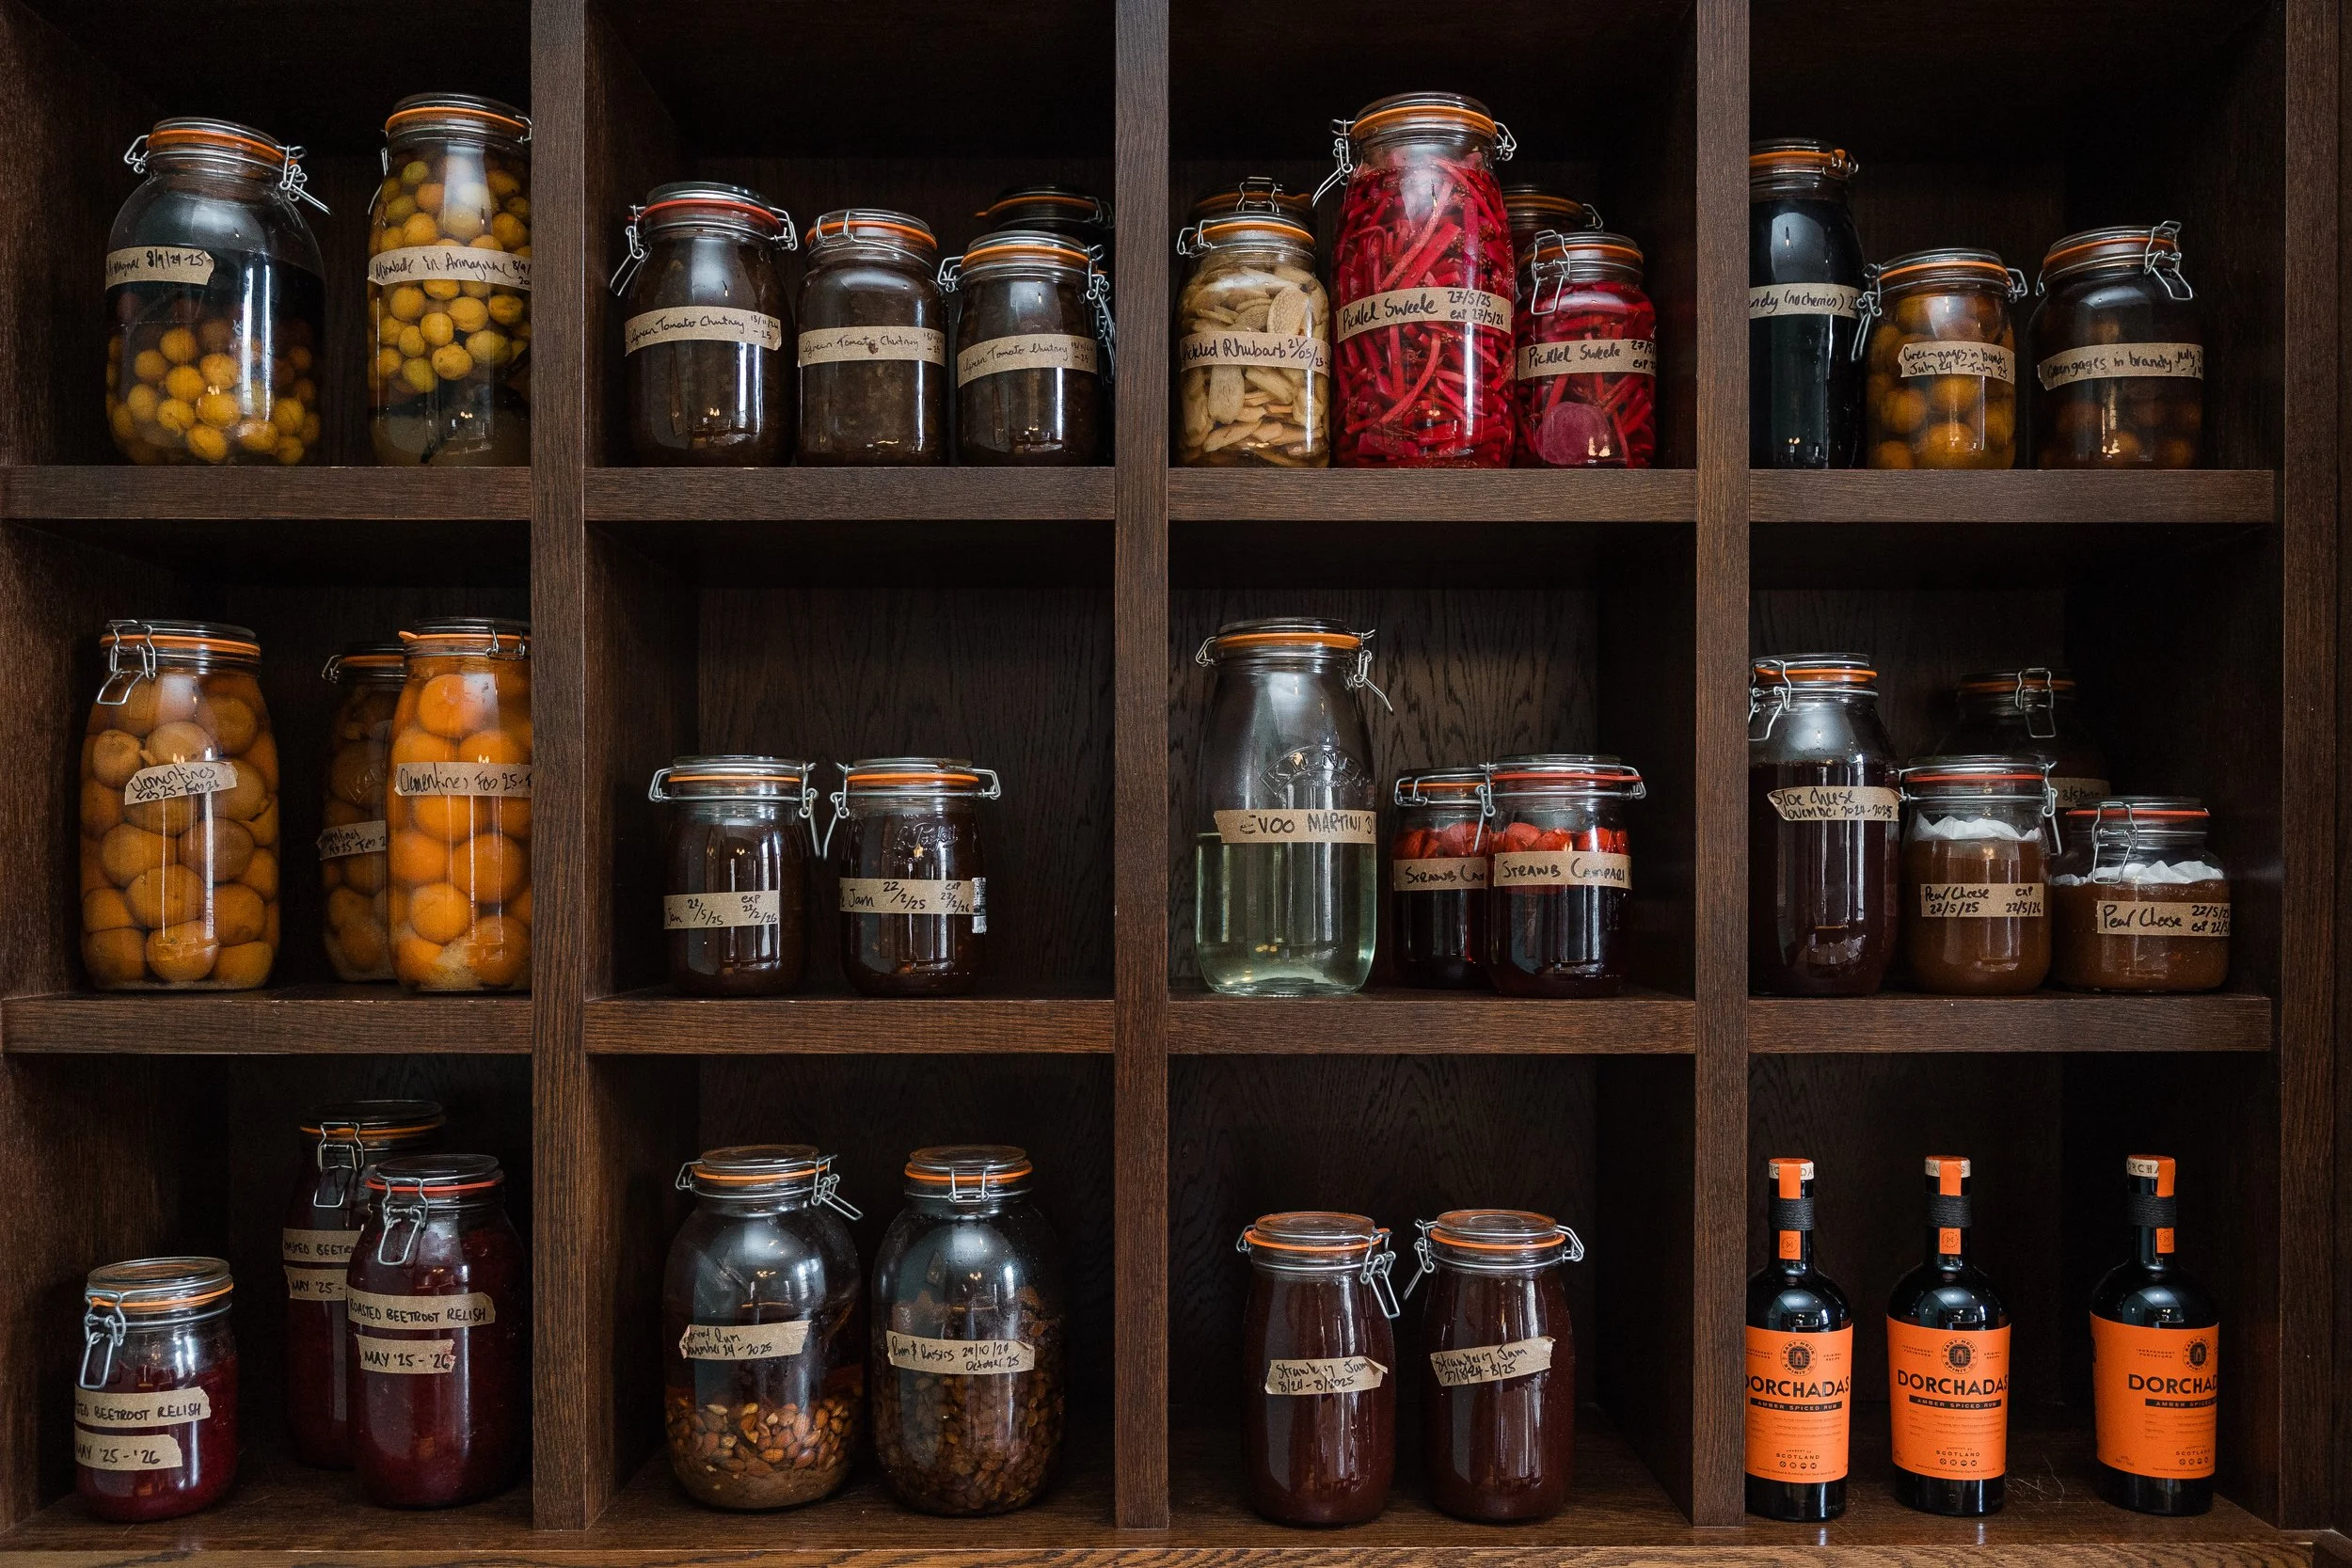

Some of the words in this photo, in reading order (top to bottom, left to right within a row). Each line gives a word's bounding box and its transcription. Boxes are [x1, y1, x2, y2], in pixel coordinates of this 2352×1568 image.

[422, 256, 439, 271] in
[630, 328, 657, 345] Green
[656, 315, 697, 331] Tomato
[700, 315, 745, 334] Chutney
[803, 341, 833, 358] Green
[836, 334, 877, 348] Tomato
[880, 335, 919, 351] Chutney
[986, 344, 1026, 362] Tomato
[1029, 342, 1068, 361] Chutney
[1223, 338, 1286, 357] Rhubarb
[2128, 351, 2172, 372] brandy
[1771, 789, 1805, 807] Sloe
[1809, 786, 1856, 806] Cheese
[1307, 812, 1361, 832] MARTINI
[849, 888, 875, 908] Jam
[1930, 901, 1979, 916] 22/5/25
[2005, 900, 2042, 915] 22/5/26
[2103, 904, 2137, 928] Pear
[2139, 907, 2183, 927] Cheese
[349, 1299, 382, 1321] ROASTED
[386, 1308, 440, 1323] BEETROOT
[447, 1307, 486, 1322] RELISH
[715, 1327, 741, 1343] Rum
[364, 1351, 390, 1368] MAY
[1497, 1343, 1528, 1361] Jam
[1343, 1358, 1370, 1373] Jam
[1898, 1369, 2008, 1396] DORCHADAS
[94, 1406, 151, 1421] BEETROOT
[157, 1402, 201, 1418] RELISH
[1757, 1401, 1785, 1410] AMBER
[1917, 1398, 1945, 1407] AMBER
